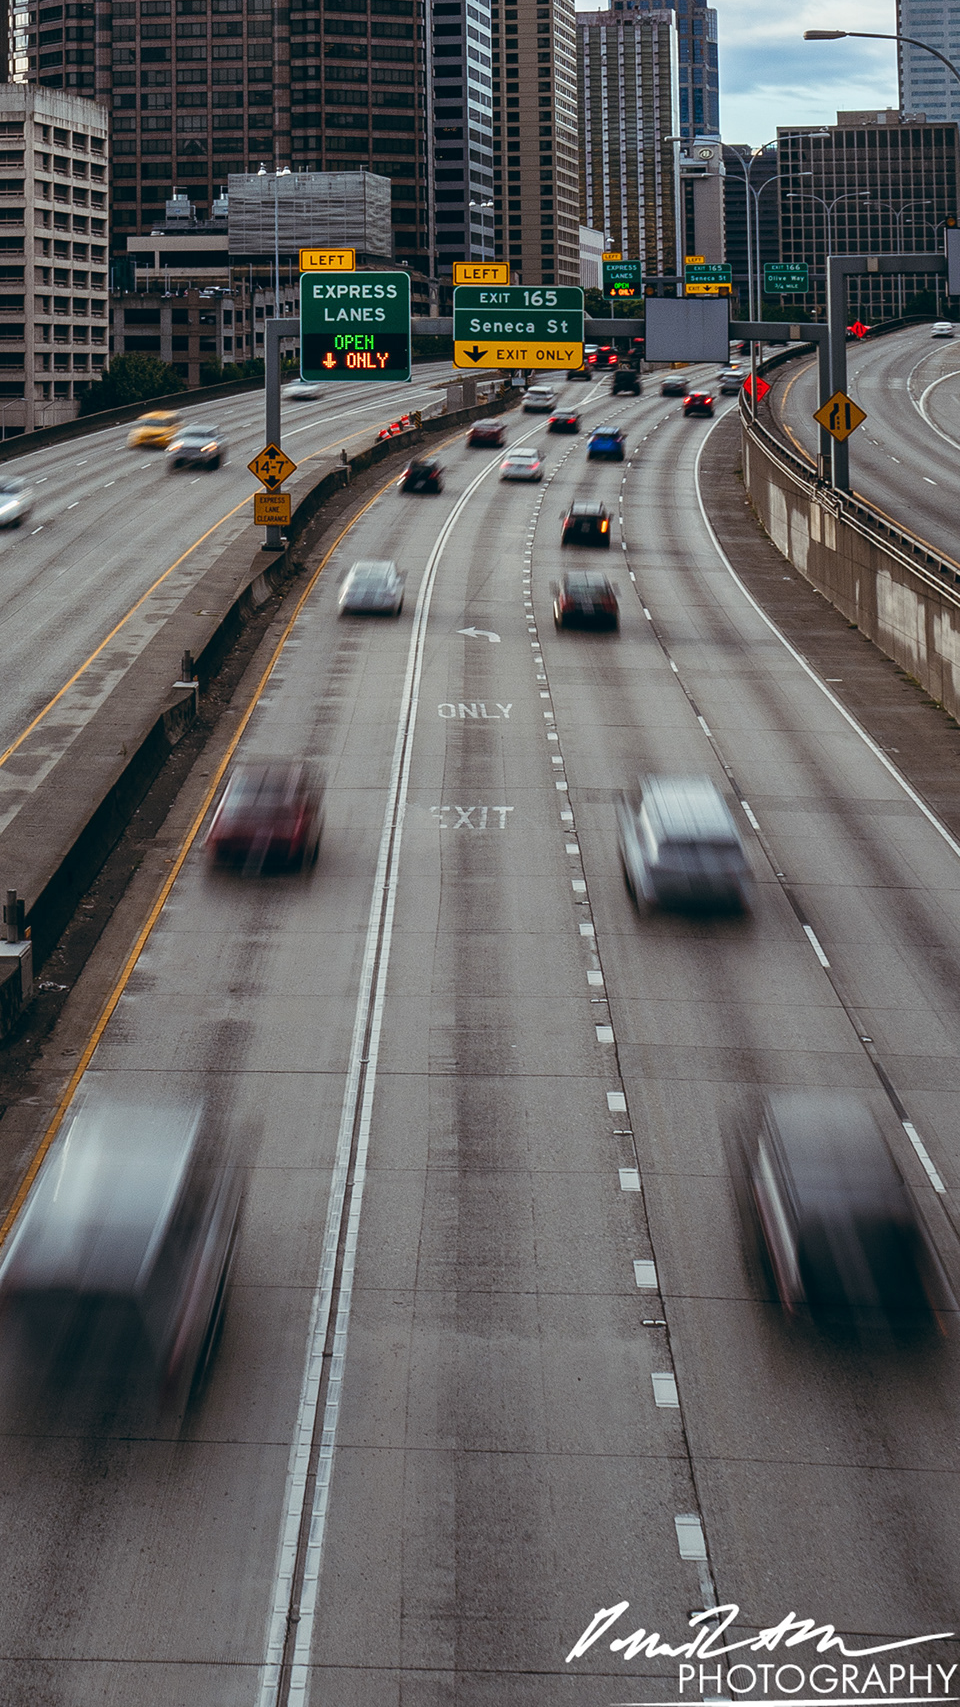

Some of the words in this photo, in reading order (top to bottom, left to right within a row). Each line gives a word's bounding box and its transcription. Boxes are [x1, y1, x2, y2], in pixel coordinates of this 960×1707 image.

[310, 255, 345, 266] LEFT
[464, 269, 499, 279] LEFT
[313, 284, 398, 299] EXPRESS
[480, 292, 511, 303] EXIT
[523, 291, 558, 306] 165
[618, 288, 635, 296] ONLY
[324, 308, 386, 322] LANES
[469, 318, 535, 333] Seneca
[547, 319, 569, 333] St
[334, 335, 374, 350] OPEN
[346, 352, 389, 368] ONLY
[497, 349, 528, 360] EXIT
[536, 350, 574, 361] ONLY
[260, 496, 285, 504] EXPRESS
[437, 703, 513, 719] ONLY
[429, 806, 515, 830] EXIT
